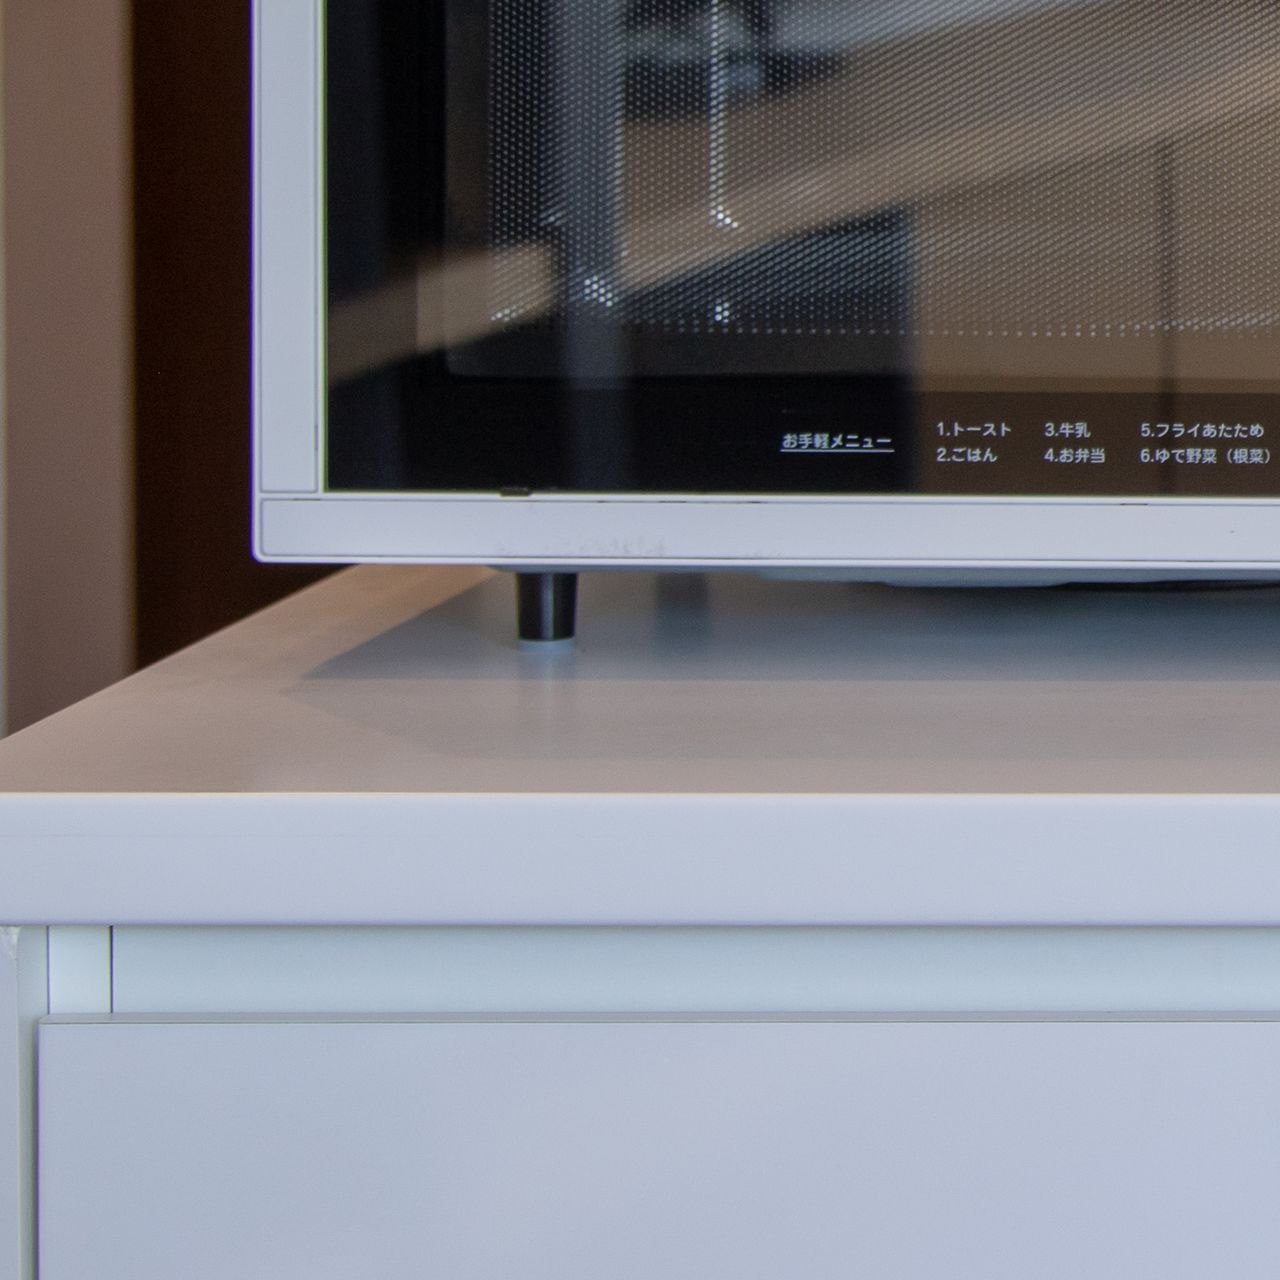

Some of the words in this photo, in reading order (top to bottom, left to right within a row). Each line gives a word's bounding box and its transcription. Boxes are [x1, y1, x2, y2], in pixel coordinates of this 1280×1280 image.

[936, 421, 1012, 438] 1.トースト
[1044, 421, 1092, 439] 3.牛乳
[1140, 422, 1265, 439] 5.フライあたため
[782, 432, 893, 449] お手軽メニュー
[936, 447, 998, 464] 2.ごはん
[1043, 446, 1106, 464] 4.お弁当
